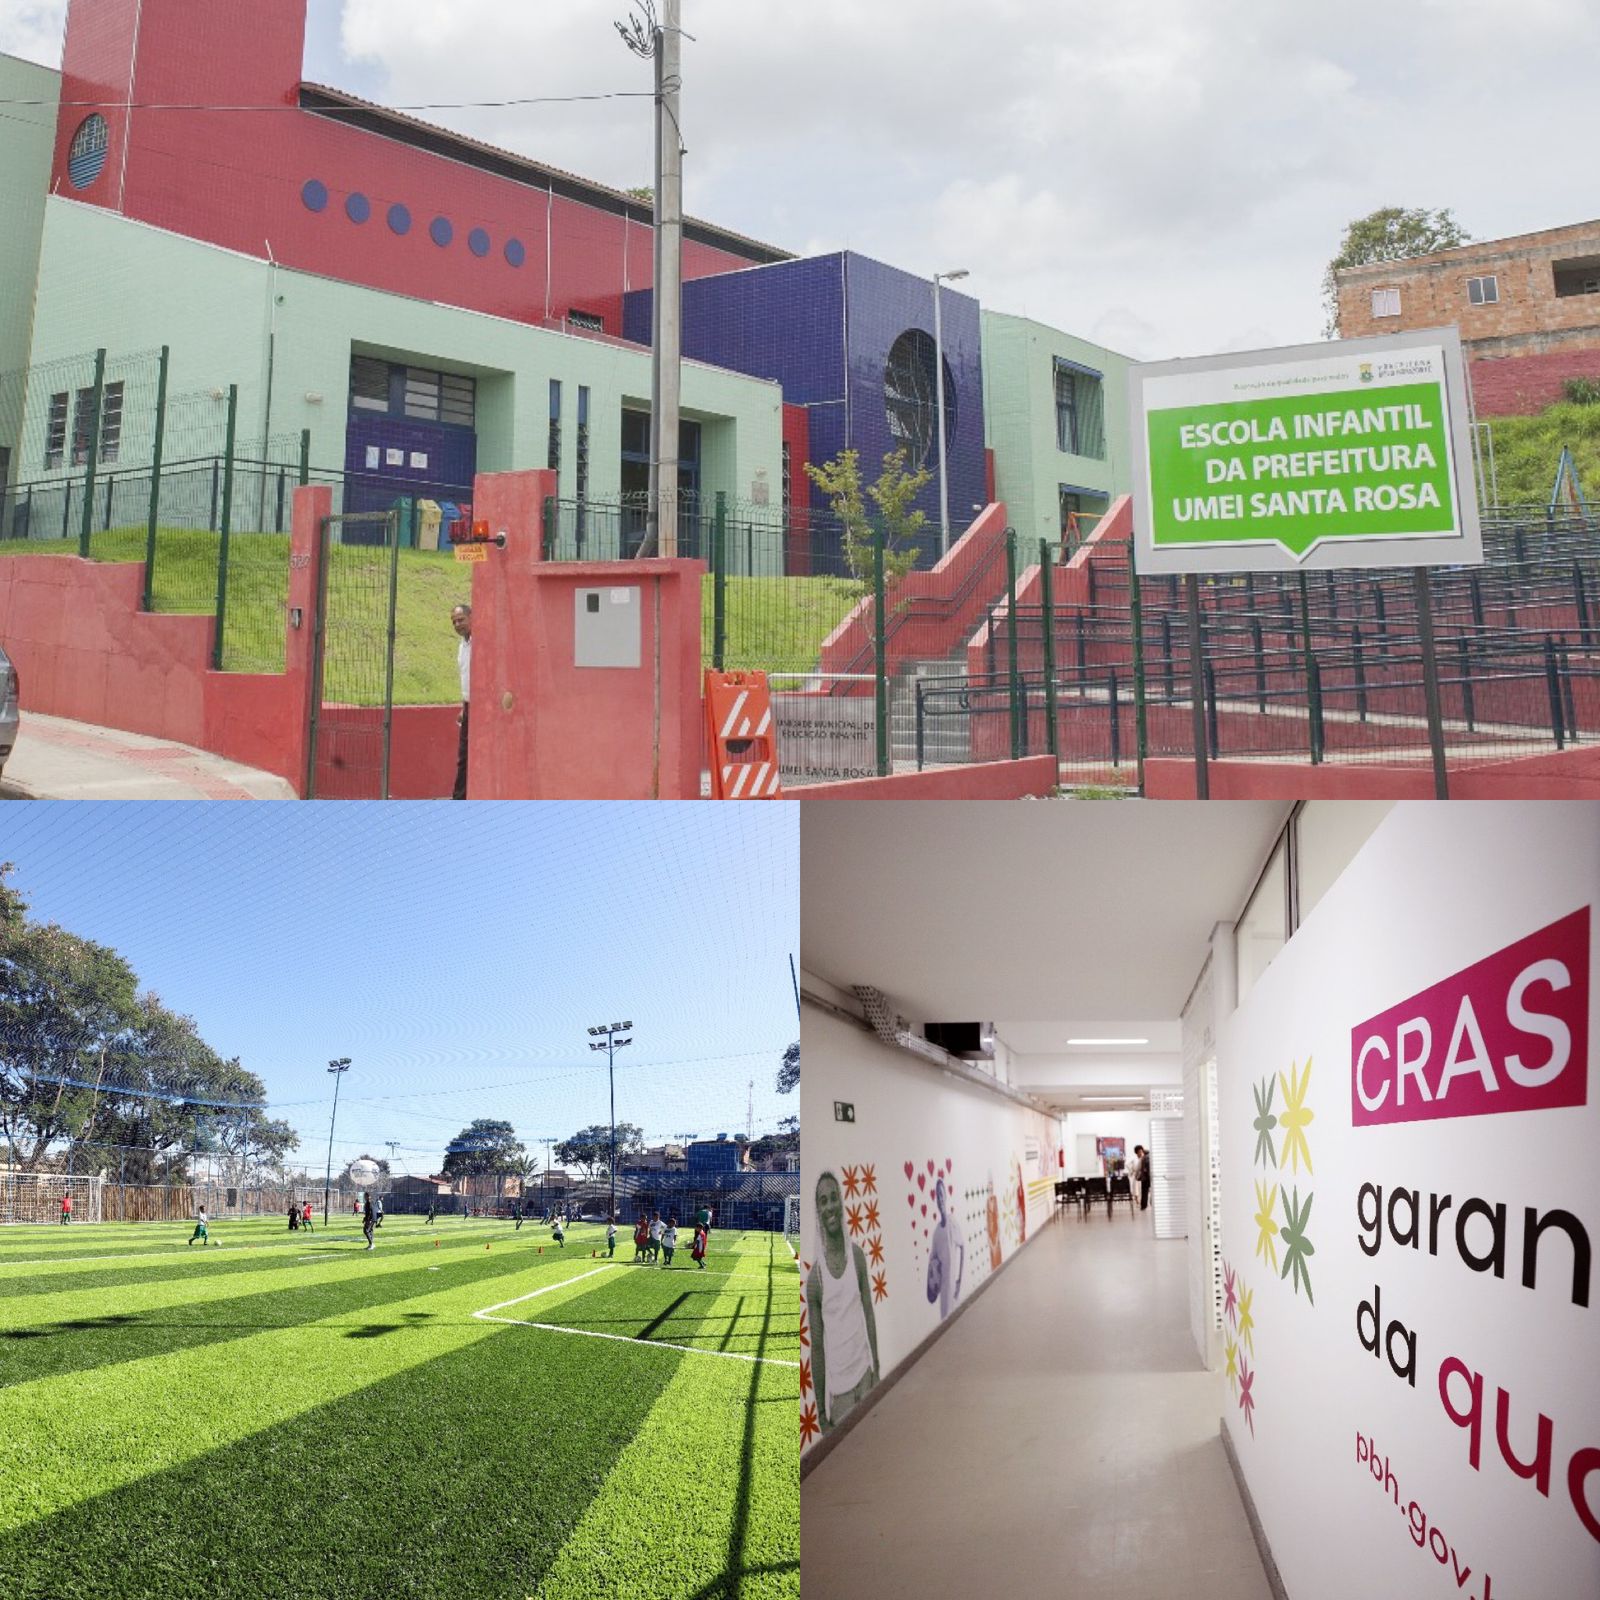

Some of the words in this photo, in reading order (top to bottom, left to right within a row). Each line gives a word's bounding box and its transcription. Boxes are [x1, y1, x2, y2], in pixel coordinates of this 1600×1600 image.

[1180, 417, 1288, 449] ESCOLA
[1294, 404, 1432, 440] INFANTIL
[1205, 457, 1247, 484] DA
[1252, 443, 1437, 481] PREFEITURA
[1172, 494, 1244, 522] UMEI
[1250, 488, 1347, 518] SANTA
[1353, 482, 1441, 513] ROSA
[778, 764, 803, 776] UMEI
[805, 765, 840, 778] SANTA
[1355, 959, 1571, 1112] CRAS
[1357, 1182, 1592, 1309] garan
[1356, 1284, 1417, 1388] da
